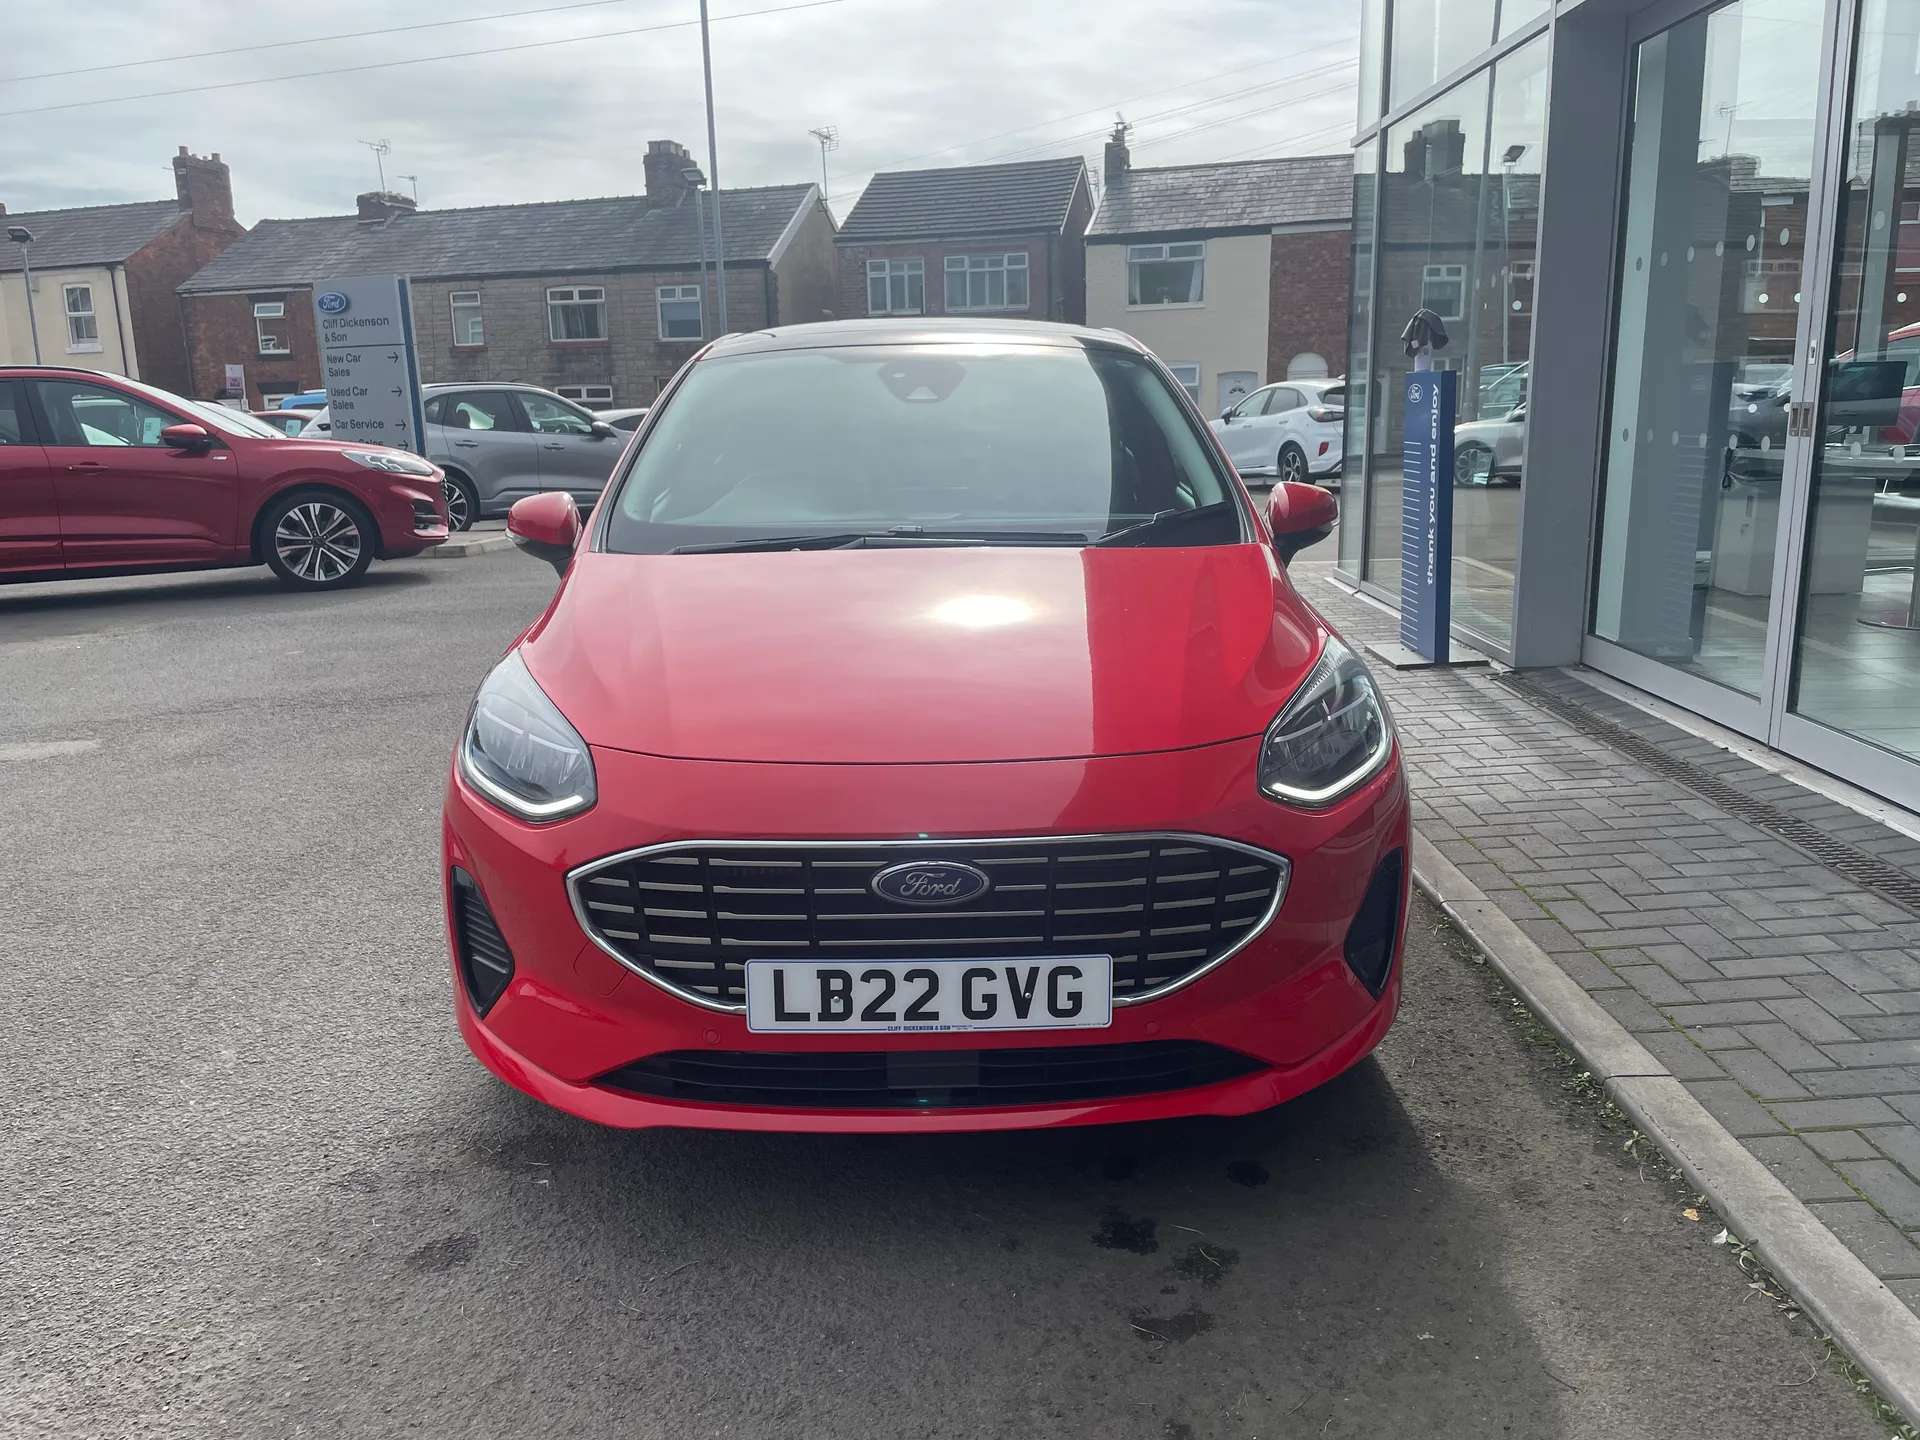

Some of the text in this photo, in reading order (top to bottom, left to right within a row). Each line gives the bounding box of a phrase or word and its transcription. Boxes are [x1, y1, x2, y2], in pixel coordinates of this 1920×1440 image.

[323, 317, 390, 329] Cliff Dickenson
[325, 332, 348, 342] & Son
[327, 353, 361, 364] New Car
[328, 367, 351, 377] Sales
[331, 386, 368, 397] Used Car
[332, 400, 355, 410] Sales
[335, 419, 384, 430] Car Service
[1427, 384, 1440, 585] thank you and enjoy
[900, 871, 962, 896] Ford
[772, 965, 1083, 1022] LB22 GVG
